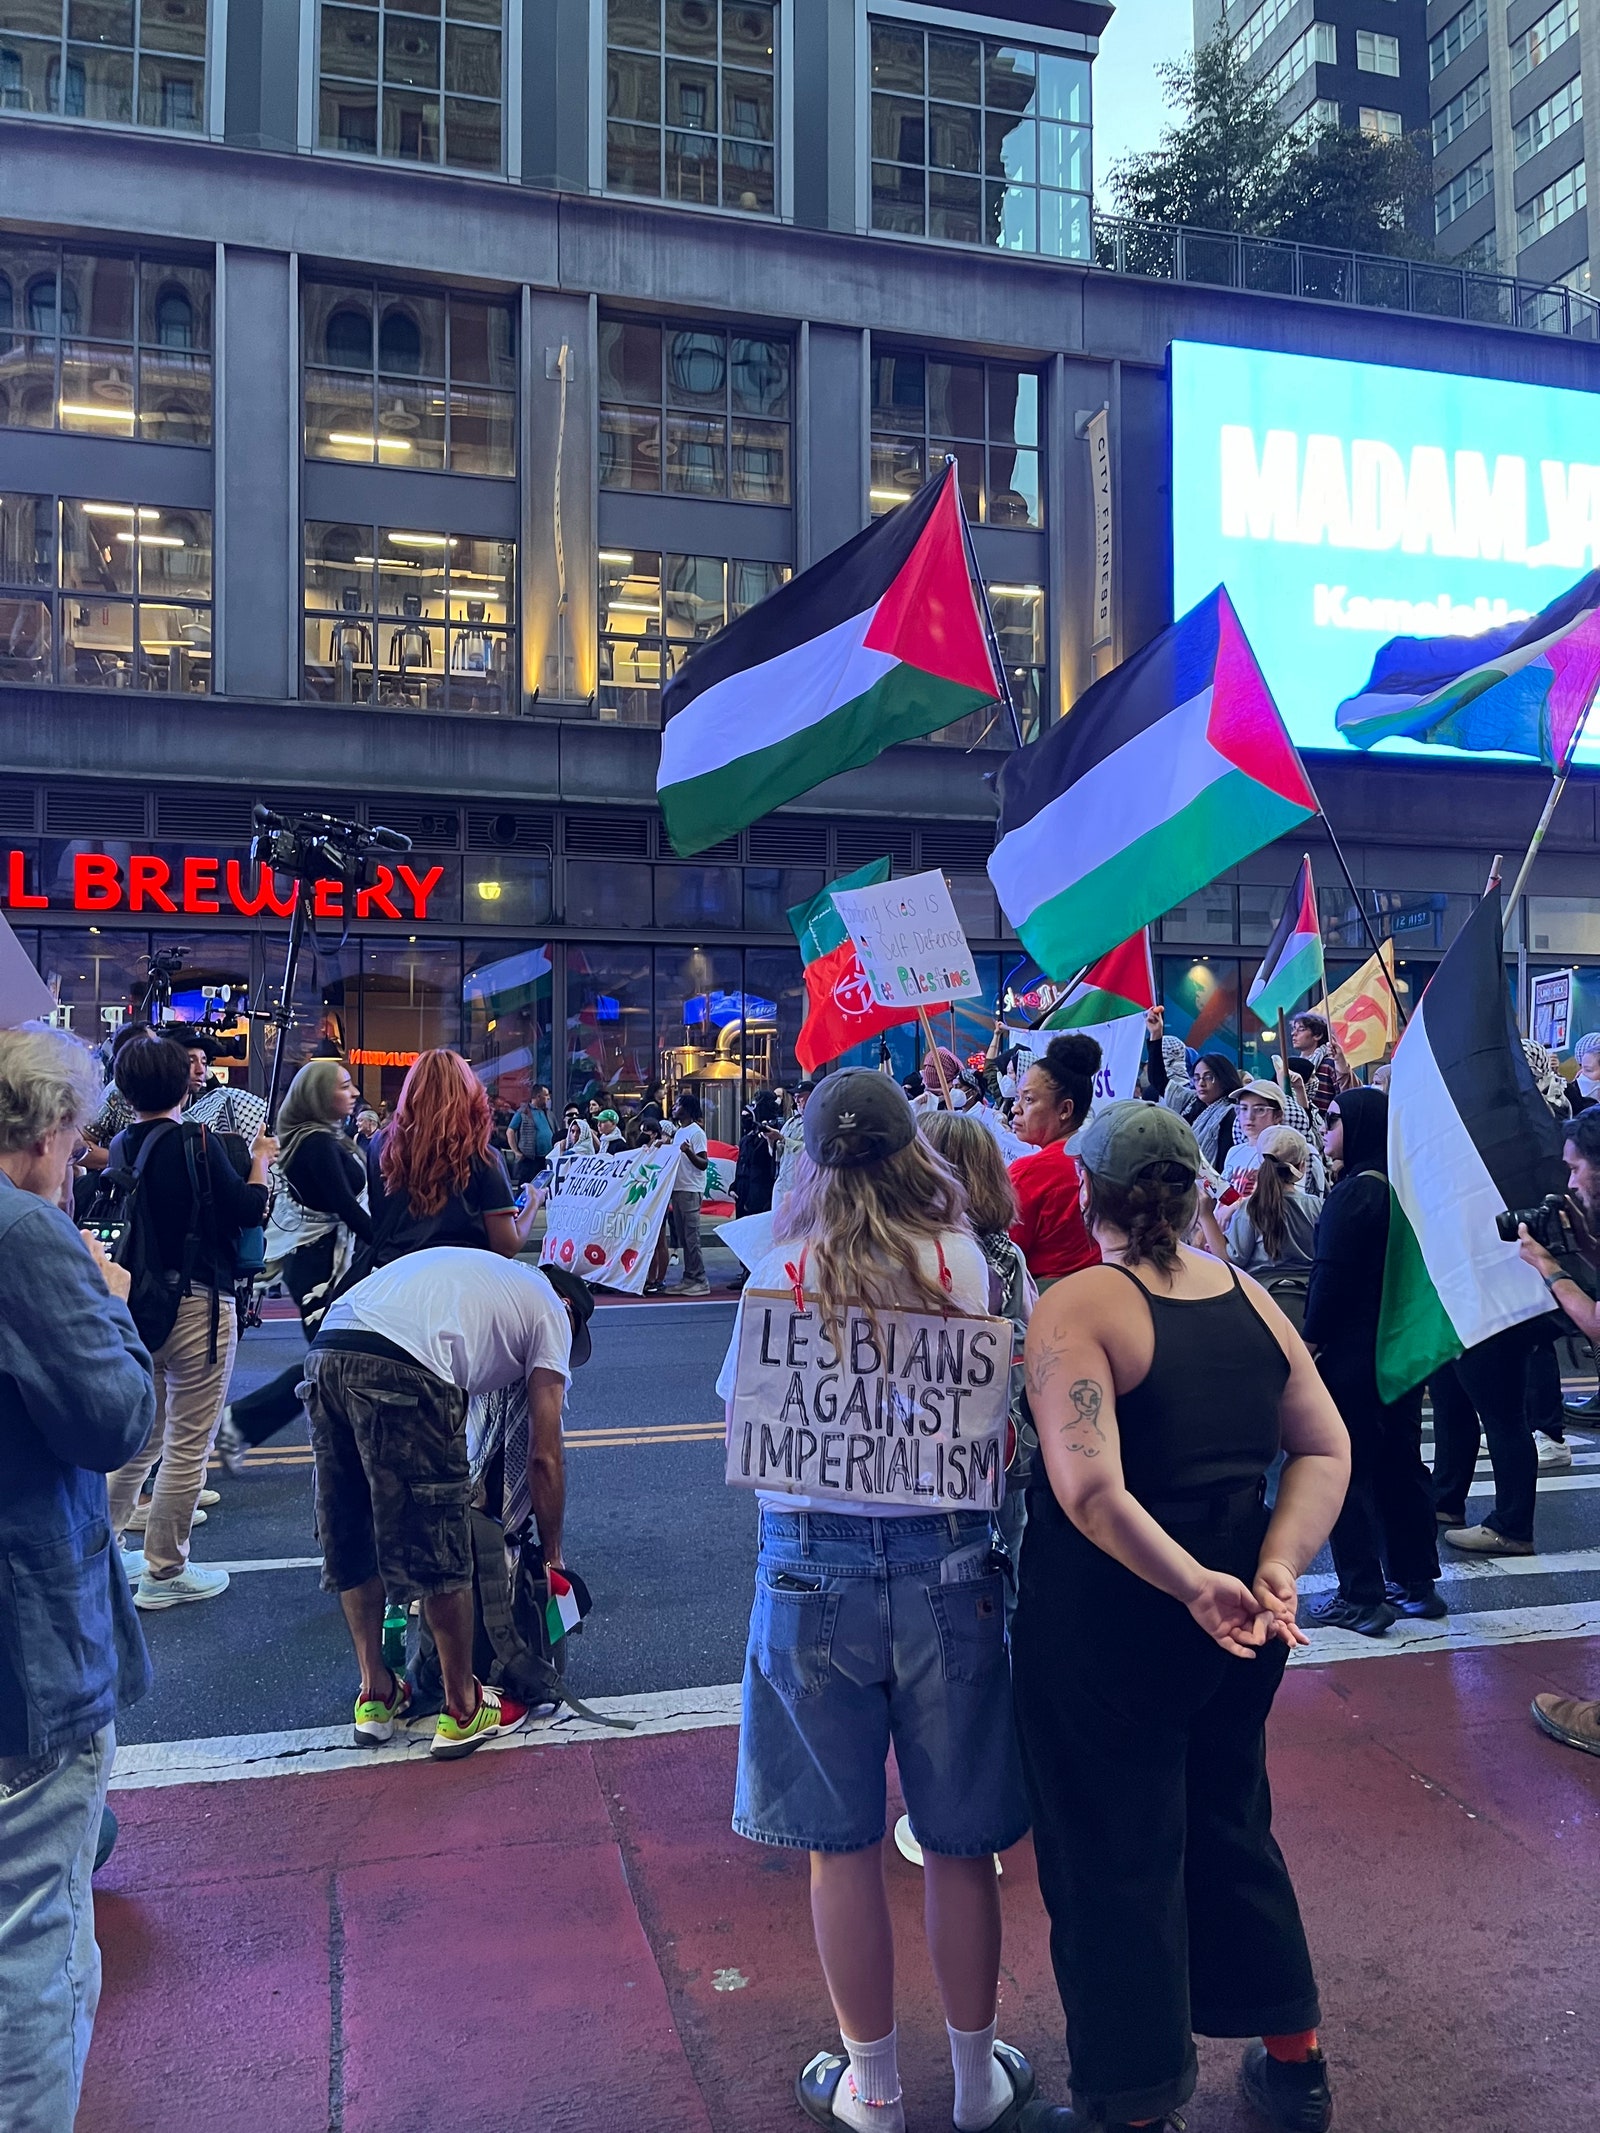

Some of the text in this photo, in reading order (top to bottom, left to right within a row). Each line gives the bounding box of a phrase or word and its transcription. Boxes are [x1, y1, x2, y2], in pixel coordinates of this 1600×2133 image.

[1097, 436, 1109, 494] CITY
[1220, 424, 1528, 565] MADAM
[1099, 507, 1110, 620] FITNESS
[74, 853, 444, 918] BREWERY
[914, 927, 965, 955] Defense
[896, 965, 971, 998] Palestine
[1092, 1063, 1116, 1098] st
[759, 1308, 997, 1387] LESBIANS
[780, 1371, 972, 1439] AGAINST
[741, 1421, 1000, 1507] IMPERIALISM
